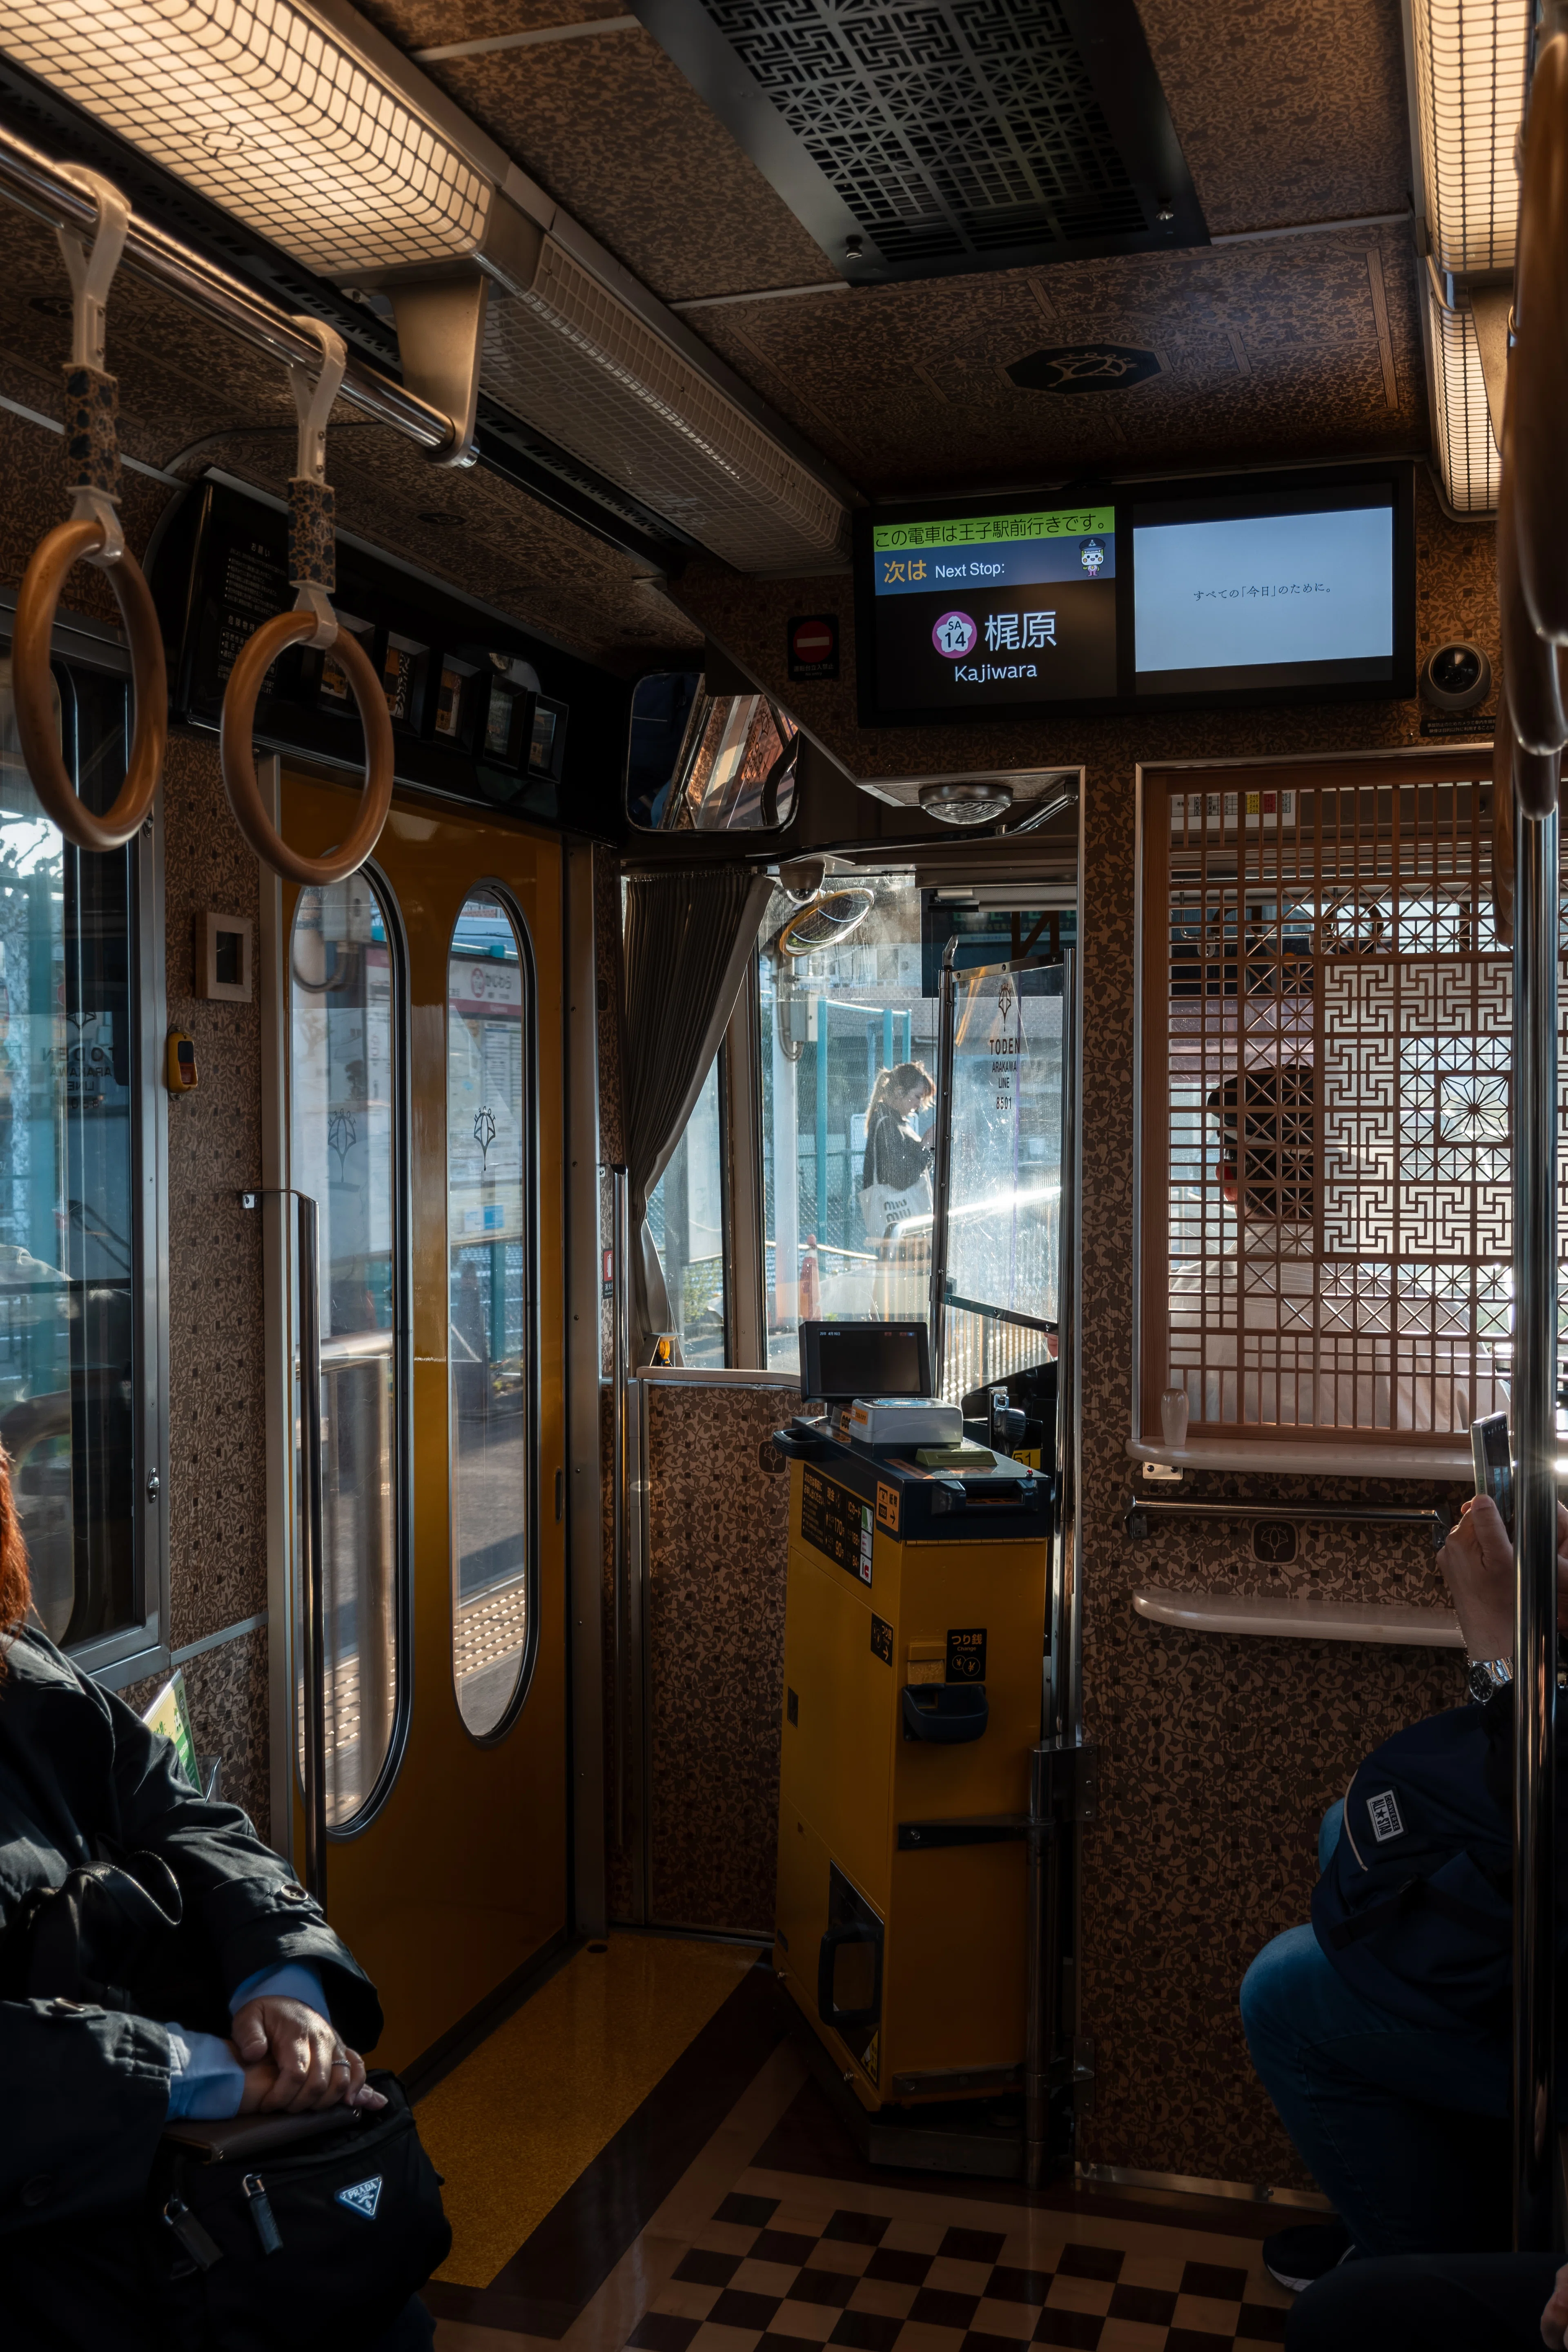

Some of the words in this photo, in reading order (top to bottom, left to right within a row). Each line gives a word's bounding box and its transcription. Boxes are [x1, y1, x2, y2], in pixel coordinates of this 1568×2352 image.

[876, 514, 1104, 548] この電車は王子駅前行きです。
[884, 559, 927, 583] 次は
[935, 564, 967, 578] Next
[970, 562, 1005, 577] Stop:
[1194, 583, 1330, 601] すべての「今日」のために。
[948, 621, 962, 630] SA
[984, 611, 1057, 651] 梶原
[944, 631, 966, 648] 14
[954, 664, 1038, 683] Kajiwara
[989, 1037, 1020, 1056] TODEN
[992, 1060, 1017, 1073] ARAKAWA
[998, 1077, 1010, 1089] LINE
[996, 1096, 1012, 1109] 8501
[951, 1633, 983, 1646] つり銭
[1372, 1798, 1385, 1812] ALL
[1385, 1794, 1401, 1831] CONVERSE
[1377, 1817, 1393, 1835] STAR
[347, 2182, 377, 2200] PRADA
